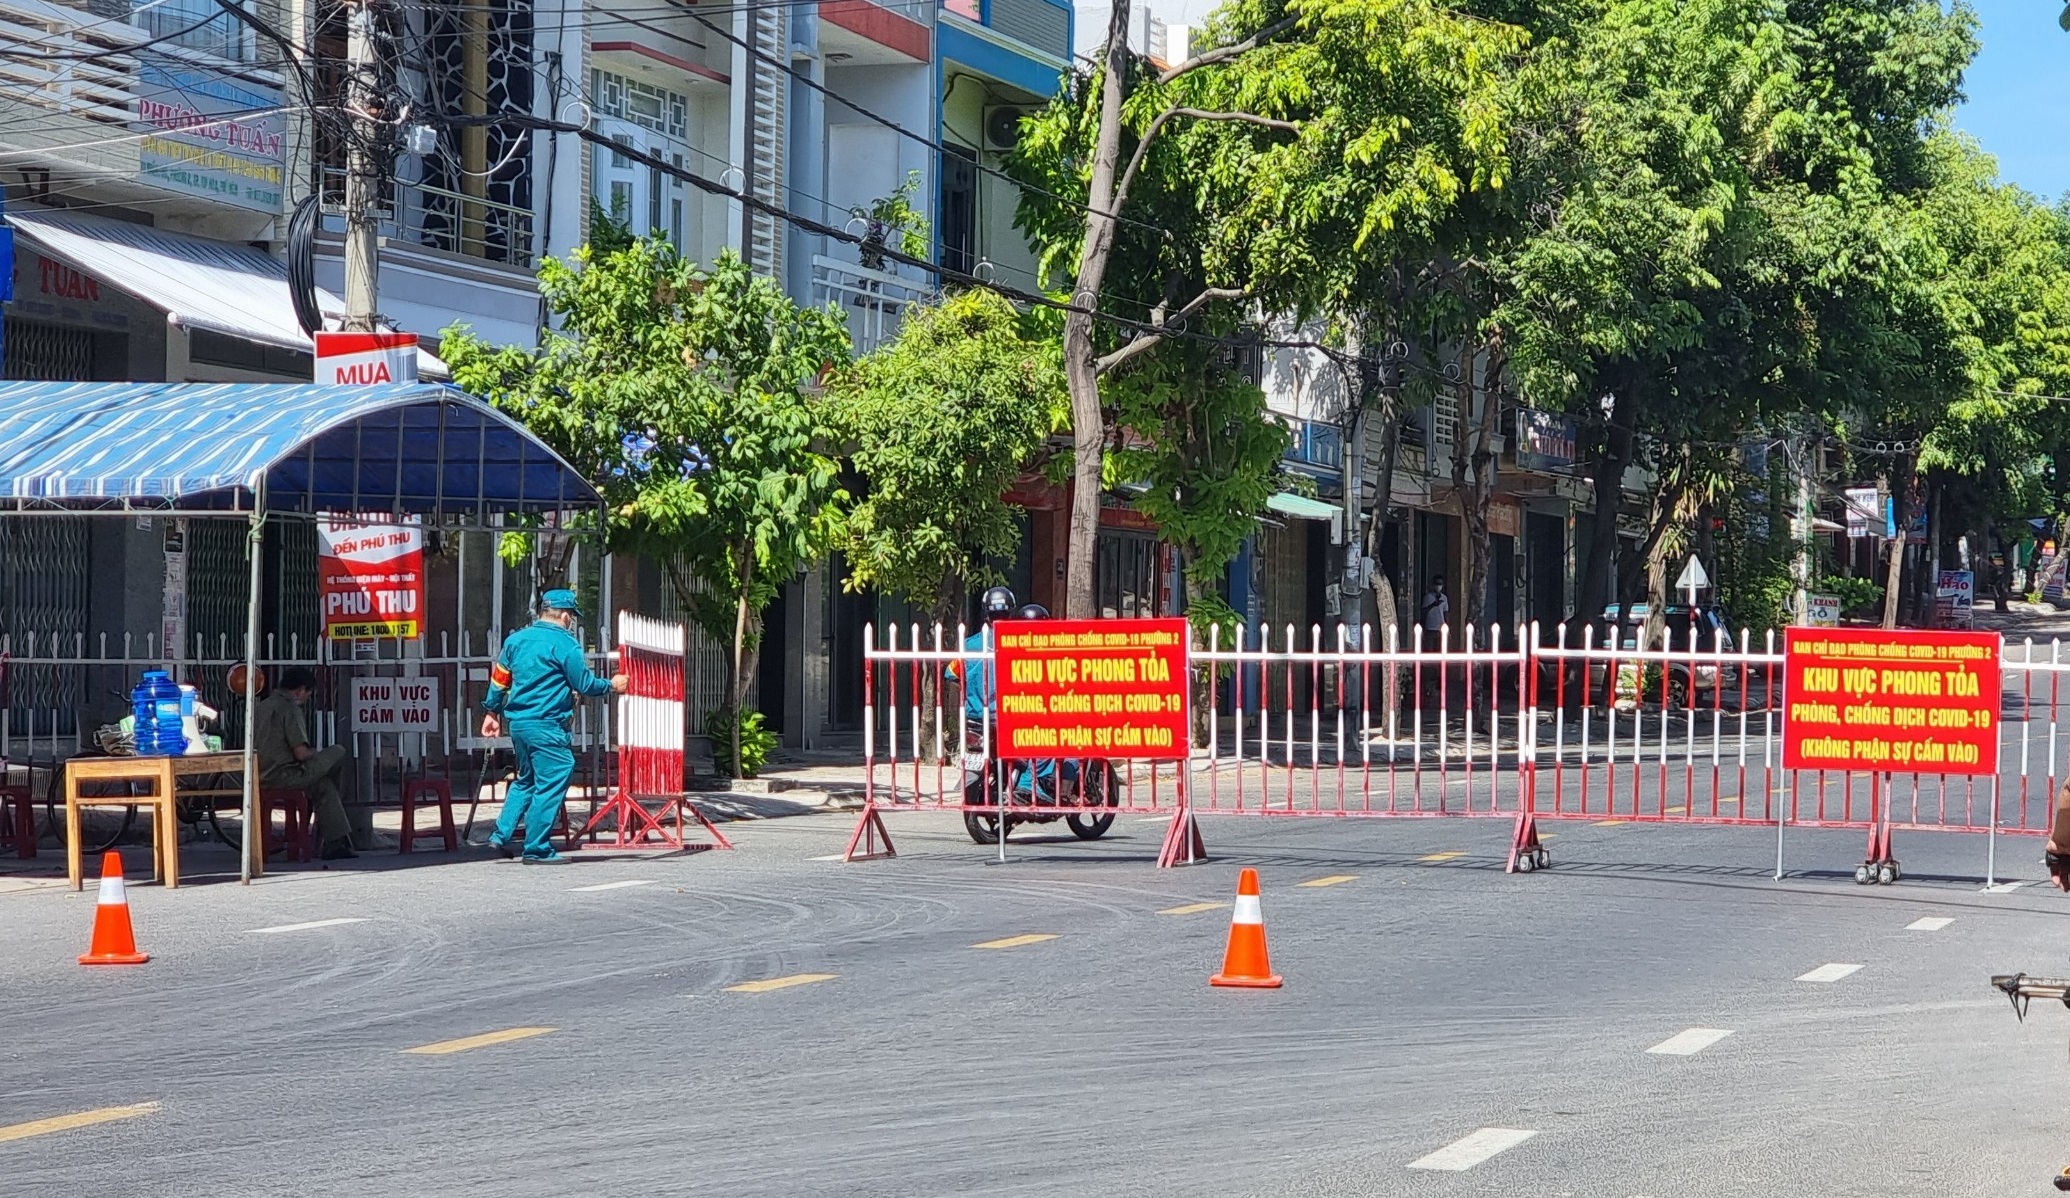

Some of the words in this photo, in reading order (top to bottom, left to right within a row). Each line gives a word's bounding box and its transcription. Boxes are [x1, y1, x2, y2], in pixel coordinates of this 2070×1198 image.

[226, 121, 282, 157] TUẤN
[336, 362, 391, 384] MUA
[333, 537, 357, 555] ĐẾN
[361, 533, 385, 550] PHÚ
[388, 532, 410, 545] THU
[328, 586, 370, 615] PHÚ
[376, 590, 416, 614] THU
[335, 625, 369, 636] HOTLINE:
[1001, 635, 1017, 647] BAN
[1019, 631, 1031, 647] CHỈ
[1033, 635, 1048, 649] ĐẠO
[1050, 632, 1075, 646] PHÒNG
[1078, 630, 1103, 646] CHỐNG
[1105, 633, 1139, 645] COVID-19
[1141, 630, 1172, 645] PHƯỜNG
[1174, 633, 1179, 644] 2
[1794, 641, 1811, 654] BAN
[1813, 639, 1827, 655] CHỈ
[1848, 641, 1876, 657] PHÒNG
[1879, 641, 1907, 657] CHỐNG
[1909, 645, 1947, 658] COVID-19
[1949, 644, 1983, 659] PHƯỜNG
[1985, 647, 1991, 659] 2
[1012, 659, 1043, 683] KHU
[1047, 657, 1077, 687] VỰC
[1081, 658, 1135, 682] PHONG
[1139, 650, 1170, 682] TỎA
[1804, 667, 1838, 692] KHU
[1843, 667, 1876, 698] VỰC
[1882, 670, 1941, 695] PHONG
[1945, 664, 1979, 696] TỎA
[360, 686, 390, 700] KHU
[399, 685, 430, 704] VỰC
[1003, 691, 1047, 714] PHÒNG,
[1051, 689, 1091, 712] CHỐNG
[1094, 694, 1122, 716] DỊCH
[1126, 694, 1180, 712] COVID-19
[359, 703, 393, 723] CẤM
[402, 705, 430, 723] VÀO
[1792, 700, 1841, 725] PHÒNG,
[1845, 701, 1890, 725] CHỐNG
[1893, 707, 1925, 729] DỊCH
[1929, 708, 1990, 728] COVID-19
[1013, 725, 1057, 748] (KHÔNG
[1060, 725, 1092, 750] PHẬN
[1095, 726, 1112, 749] SỰ
[1114, 722, 1141, 746] CẤM
[1144, 724, 1172, 747] VÀO)
[1801, 736, 1850, 759] (KHÔNG
[1854, 737, 1889, 764] PHẬN
[1893, 740, 1912, 764] SỰ
[1914, 736, 1944, 762] CẤM
[1948, 740, 1979, 764] VÀO)
